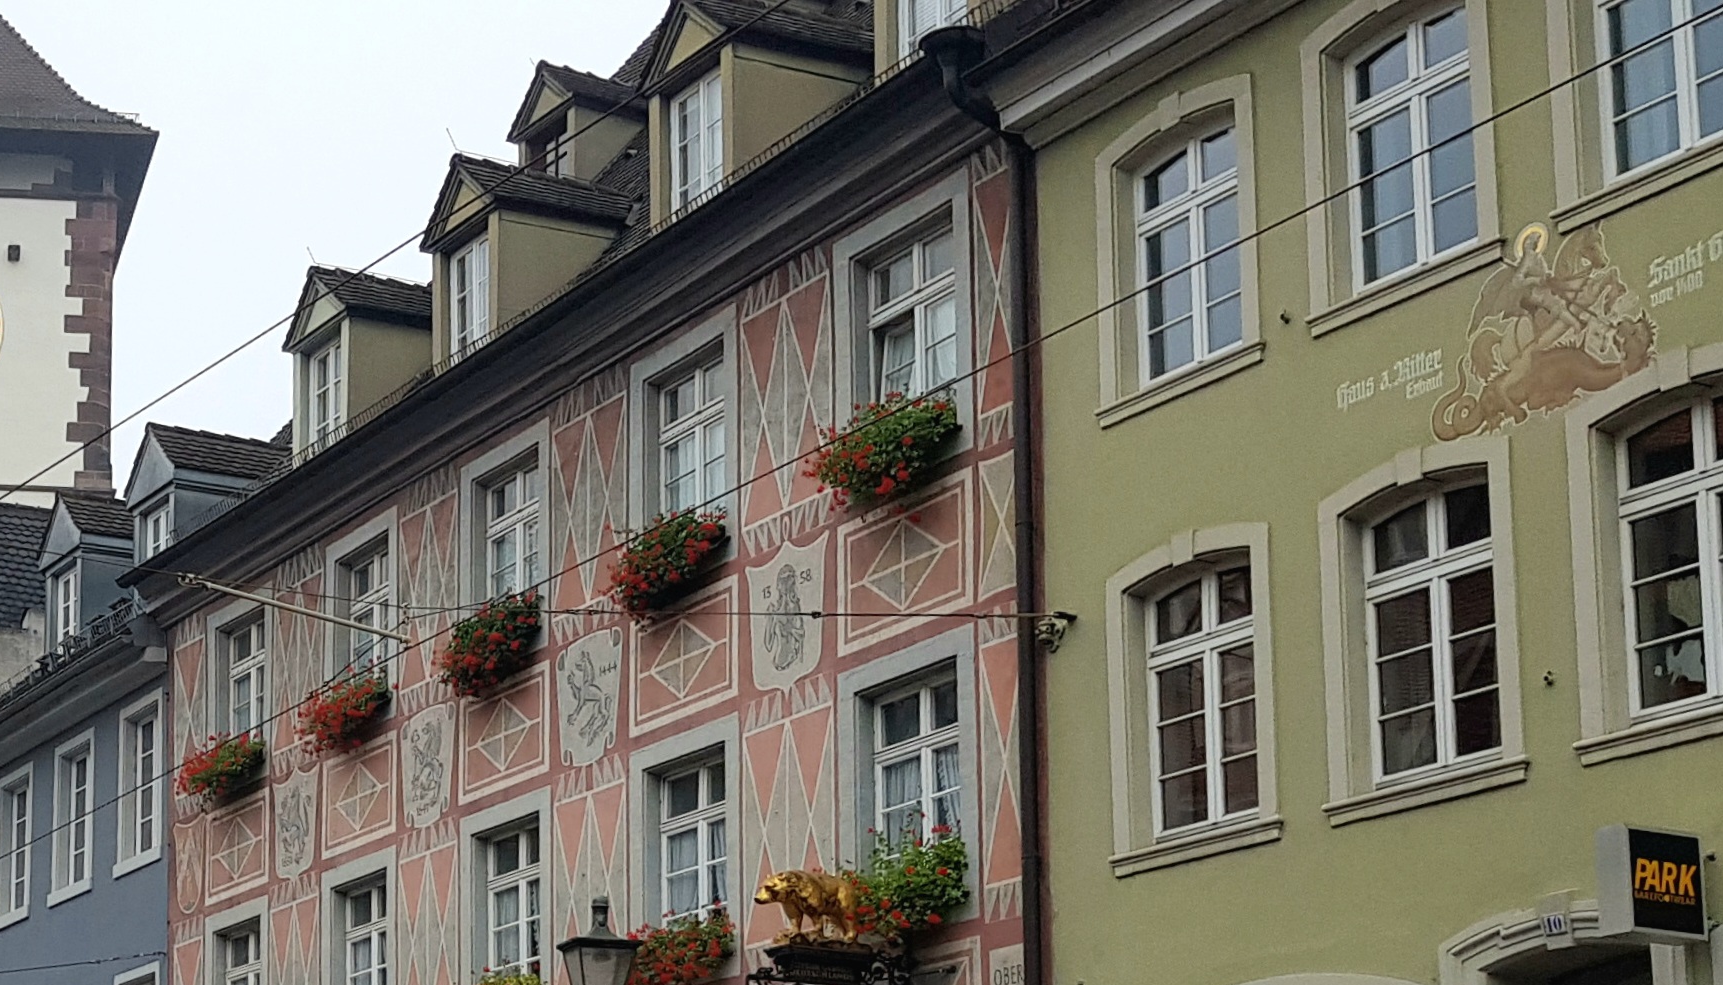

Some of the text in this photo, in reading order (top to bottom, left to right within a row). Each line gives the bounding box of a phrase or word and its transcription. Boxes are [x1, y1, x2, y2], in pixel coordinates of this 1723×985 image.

[1336, 377, 1374, 412] Haus
[1634, 857, 1698, 897] PARK
[1546, 915, 1563, 933] 10
